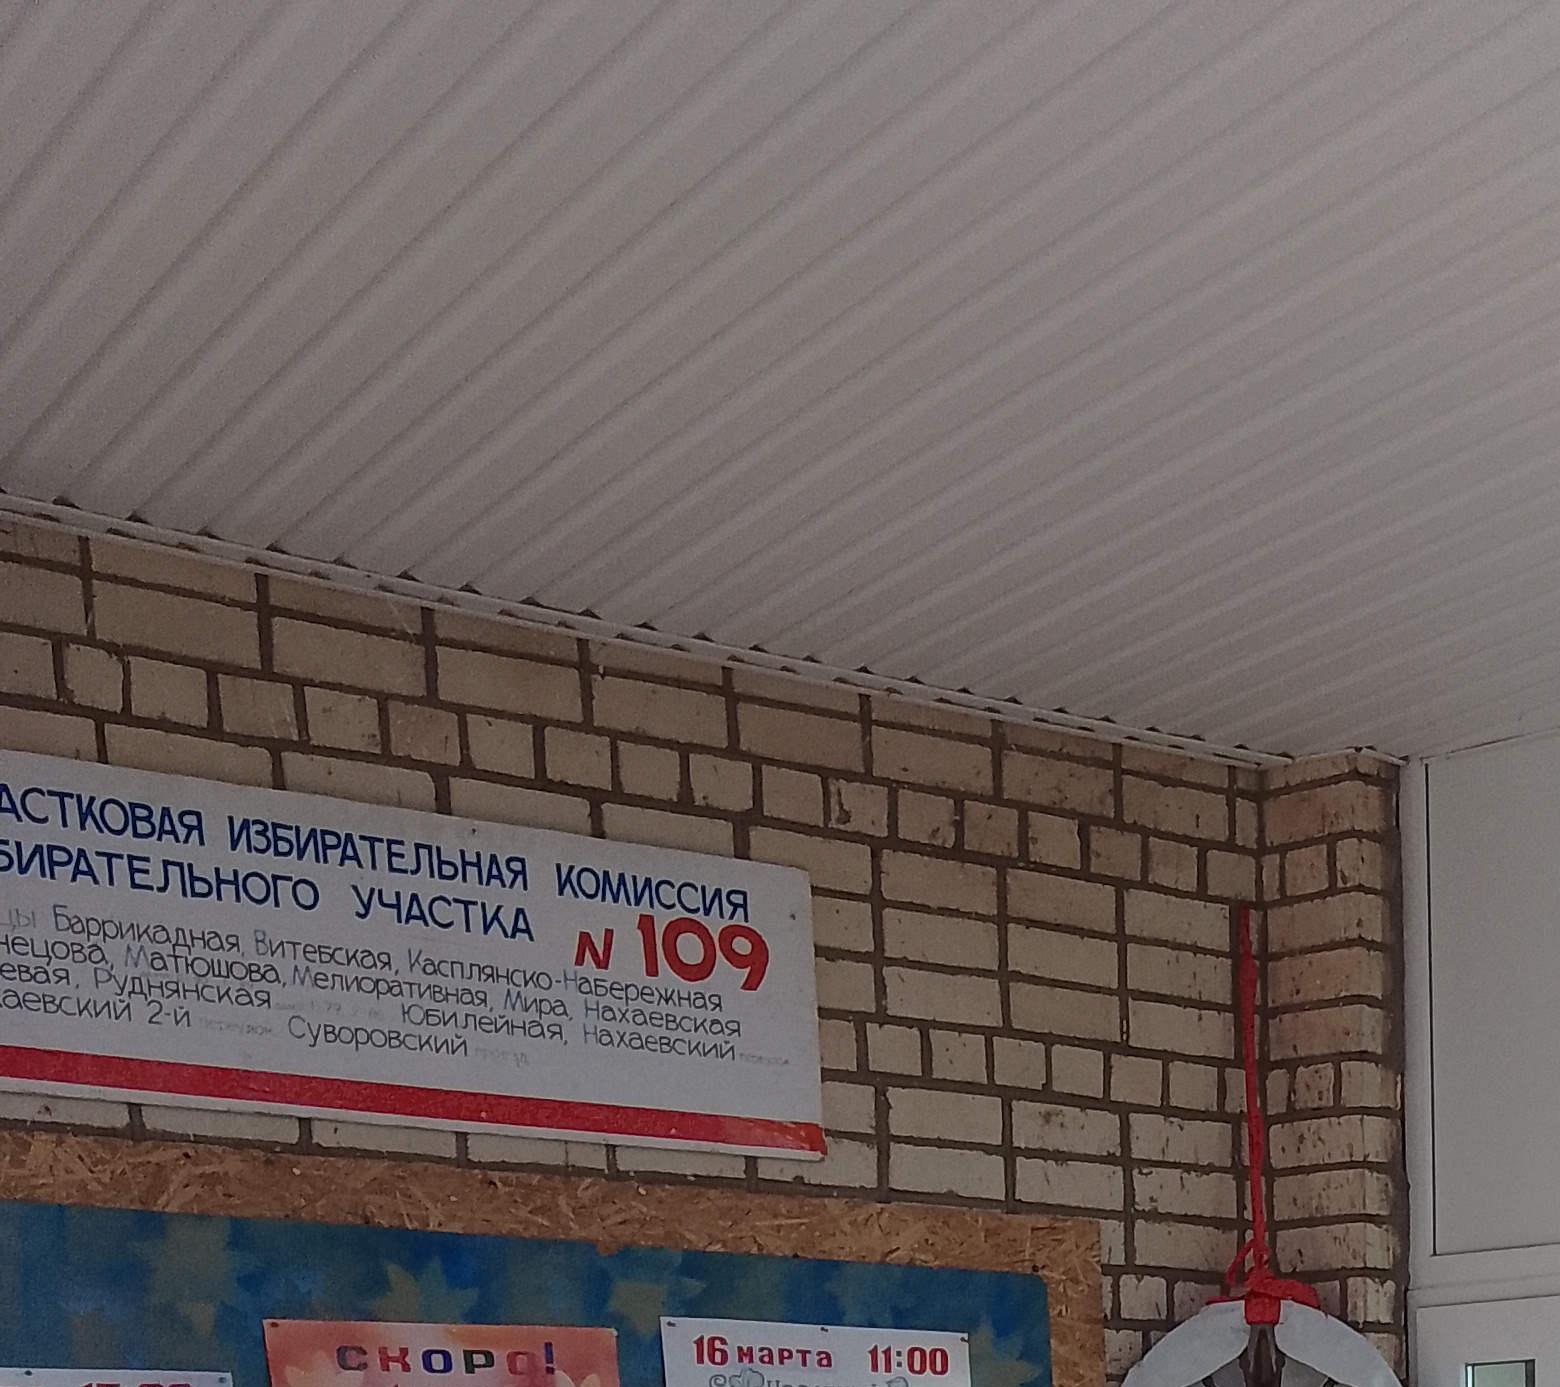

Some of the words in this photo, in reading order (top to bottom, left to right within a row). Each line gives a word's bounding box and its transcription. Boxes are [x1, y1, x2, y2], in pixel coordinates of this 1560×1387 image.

[227, 815, 529, 891] ИЗБИРАТЕЛЬНАЯ
[555, 862, 750, 923] КОМИССИЯ
[53, 904, 244, 959] Баррикадная,
[254, 929, 400, 975] Витебская,
[408, 949, 723, 1012] Касплянско-Набережная
[351, 884, 535, 942] УЧАСТКА
[637, 913, 770, 991] 109
[0, 987, 132, 1023] аевский
[147, 1000, 192, 1028] 2-й
[288, 1015, 468, 1058] Суворовский
[94, 967, 272, 1010] Руднянская
[401, 1003, 568, 1047] Юбилейная,
[583, 1023, 736, 1062] Нахаевский
[125, 944, 287, 989] Матюшова,
[292, 965, 494, 1013] Мелиоративная,
[503, 988, 573, 1022] Мира,
[585, 1003, 742, 1038] Нахаевская
[692, 1334, 730, 1367] 16
[736, 1344, 834, 1369] марта
[867, 1344, 949, 1376] 11:00
